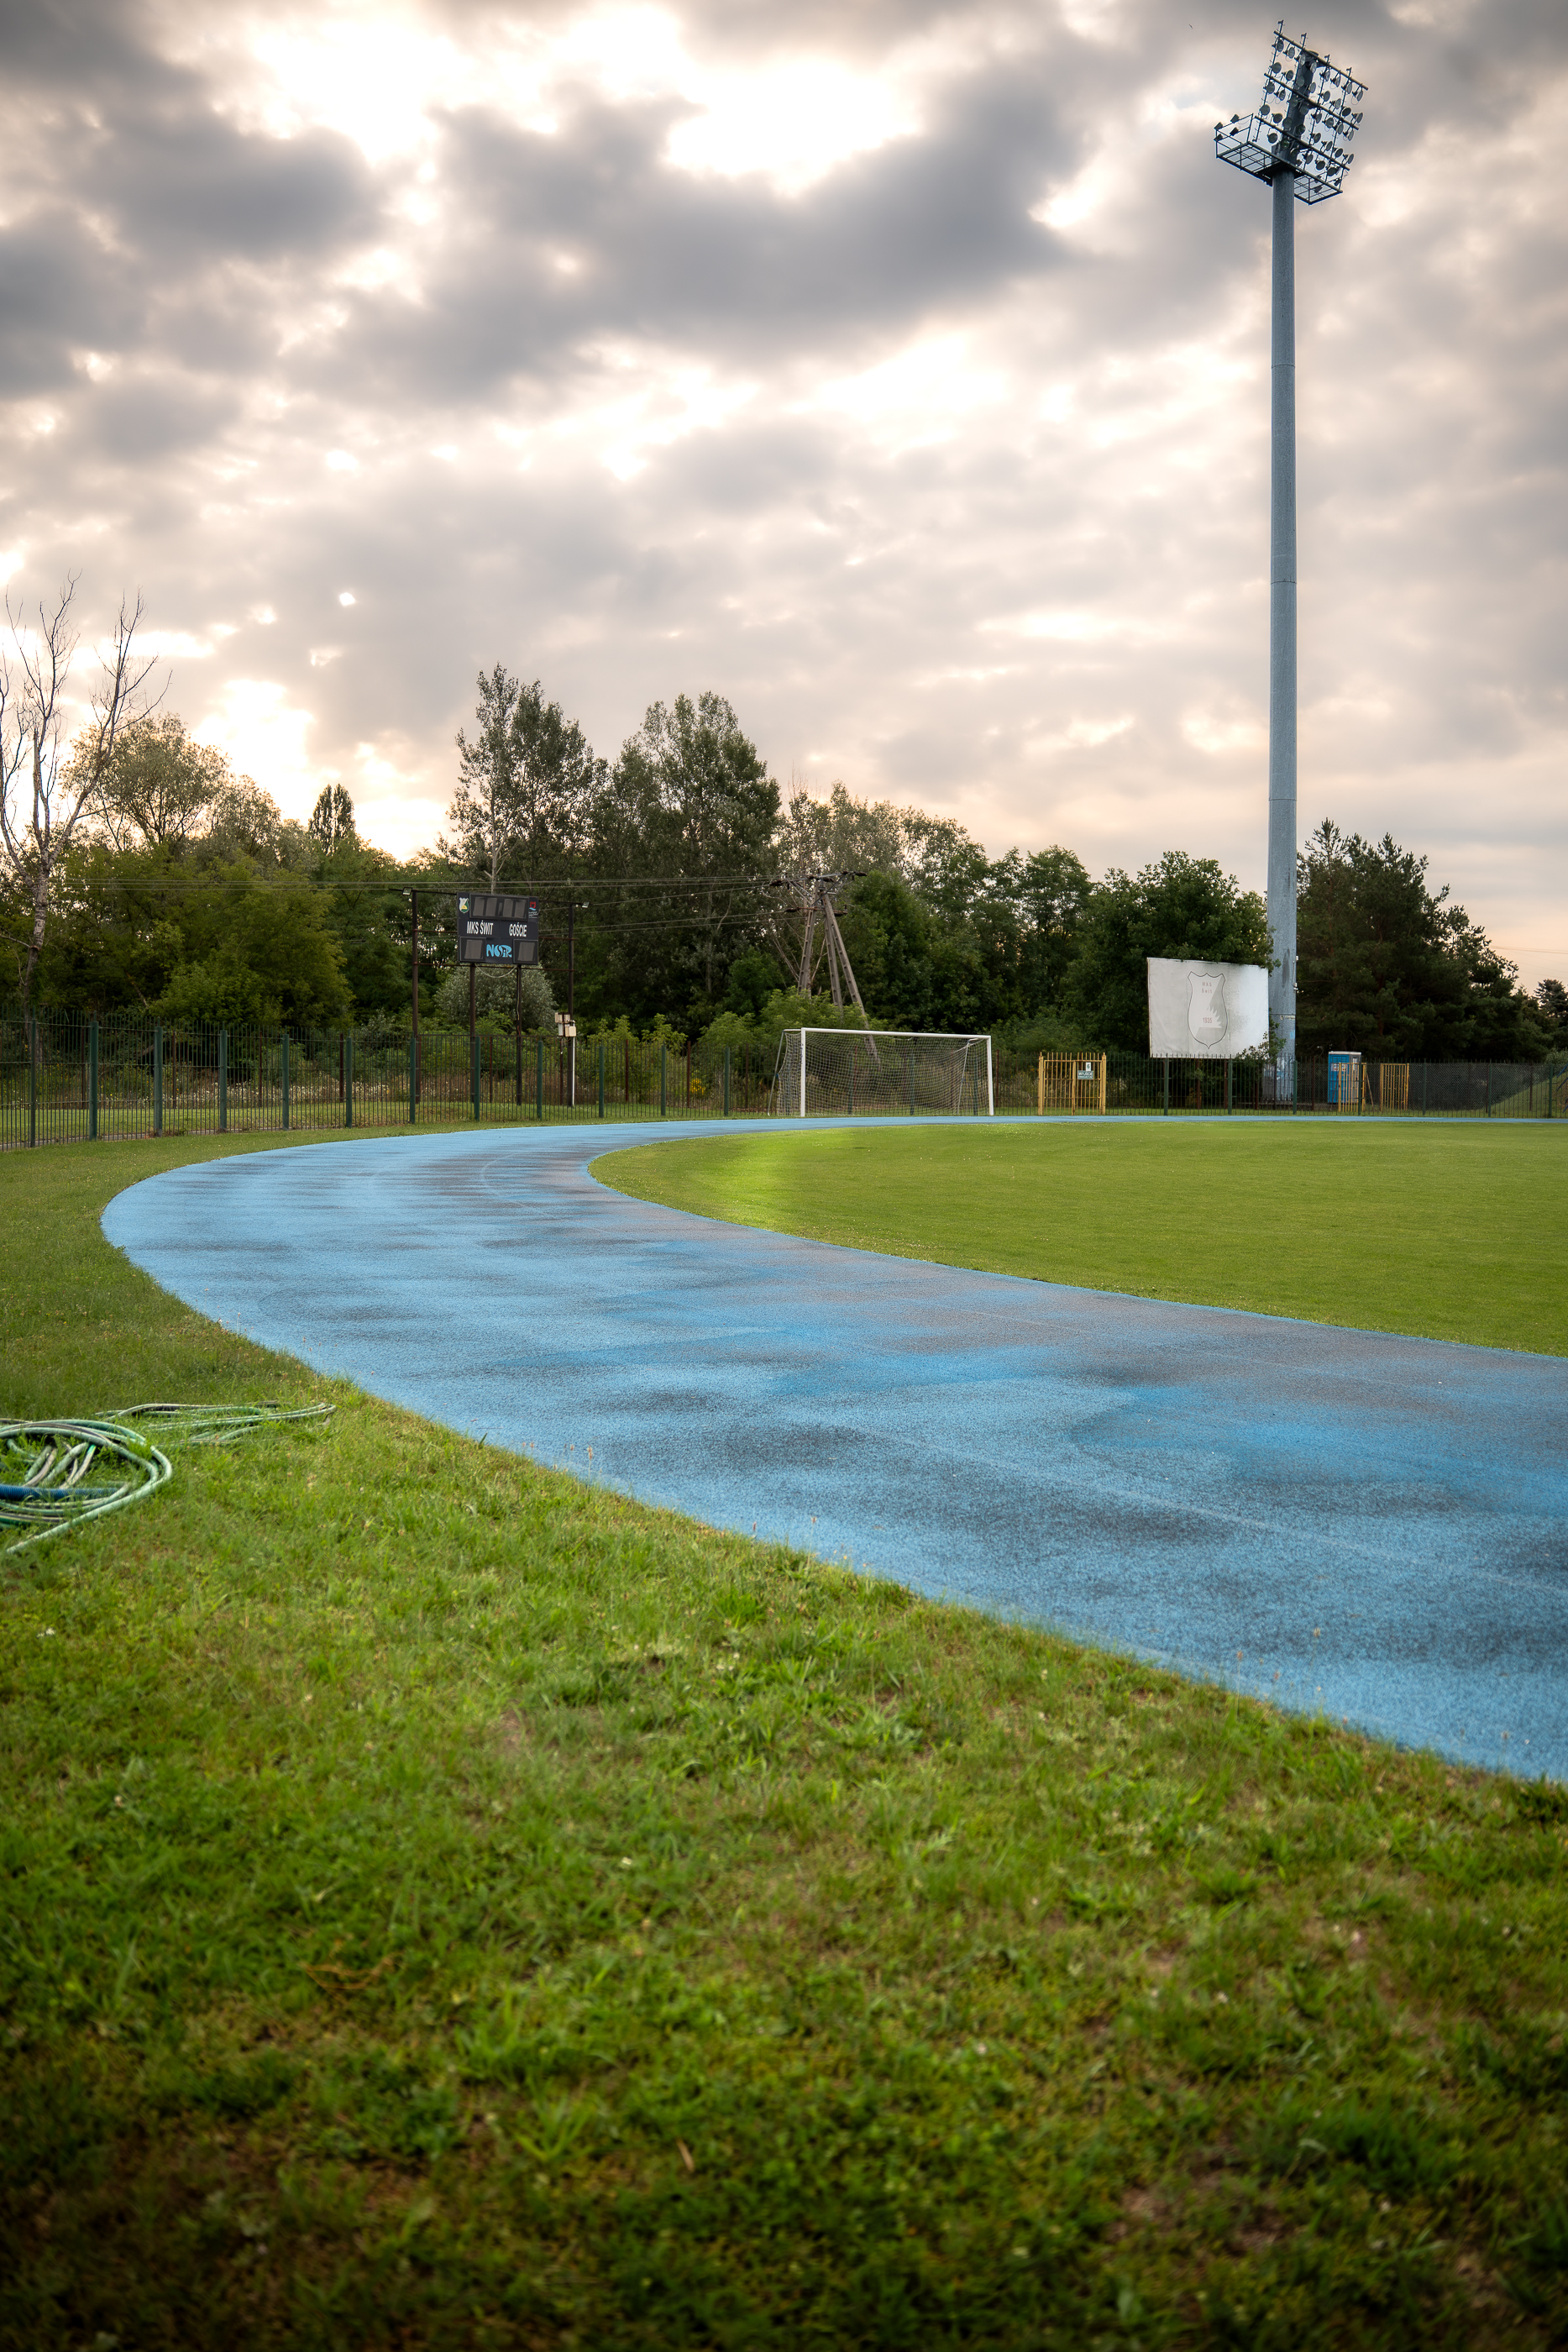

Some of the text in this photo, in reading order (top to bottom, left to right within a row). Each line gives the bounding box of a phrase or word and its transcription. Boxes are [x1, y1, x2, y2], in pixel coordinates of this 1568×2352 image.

[467, 920, 493, 935] MKS ŚWIT
[509, 922, 527, 937] GOŚCIE
